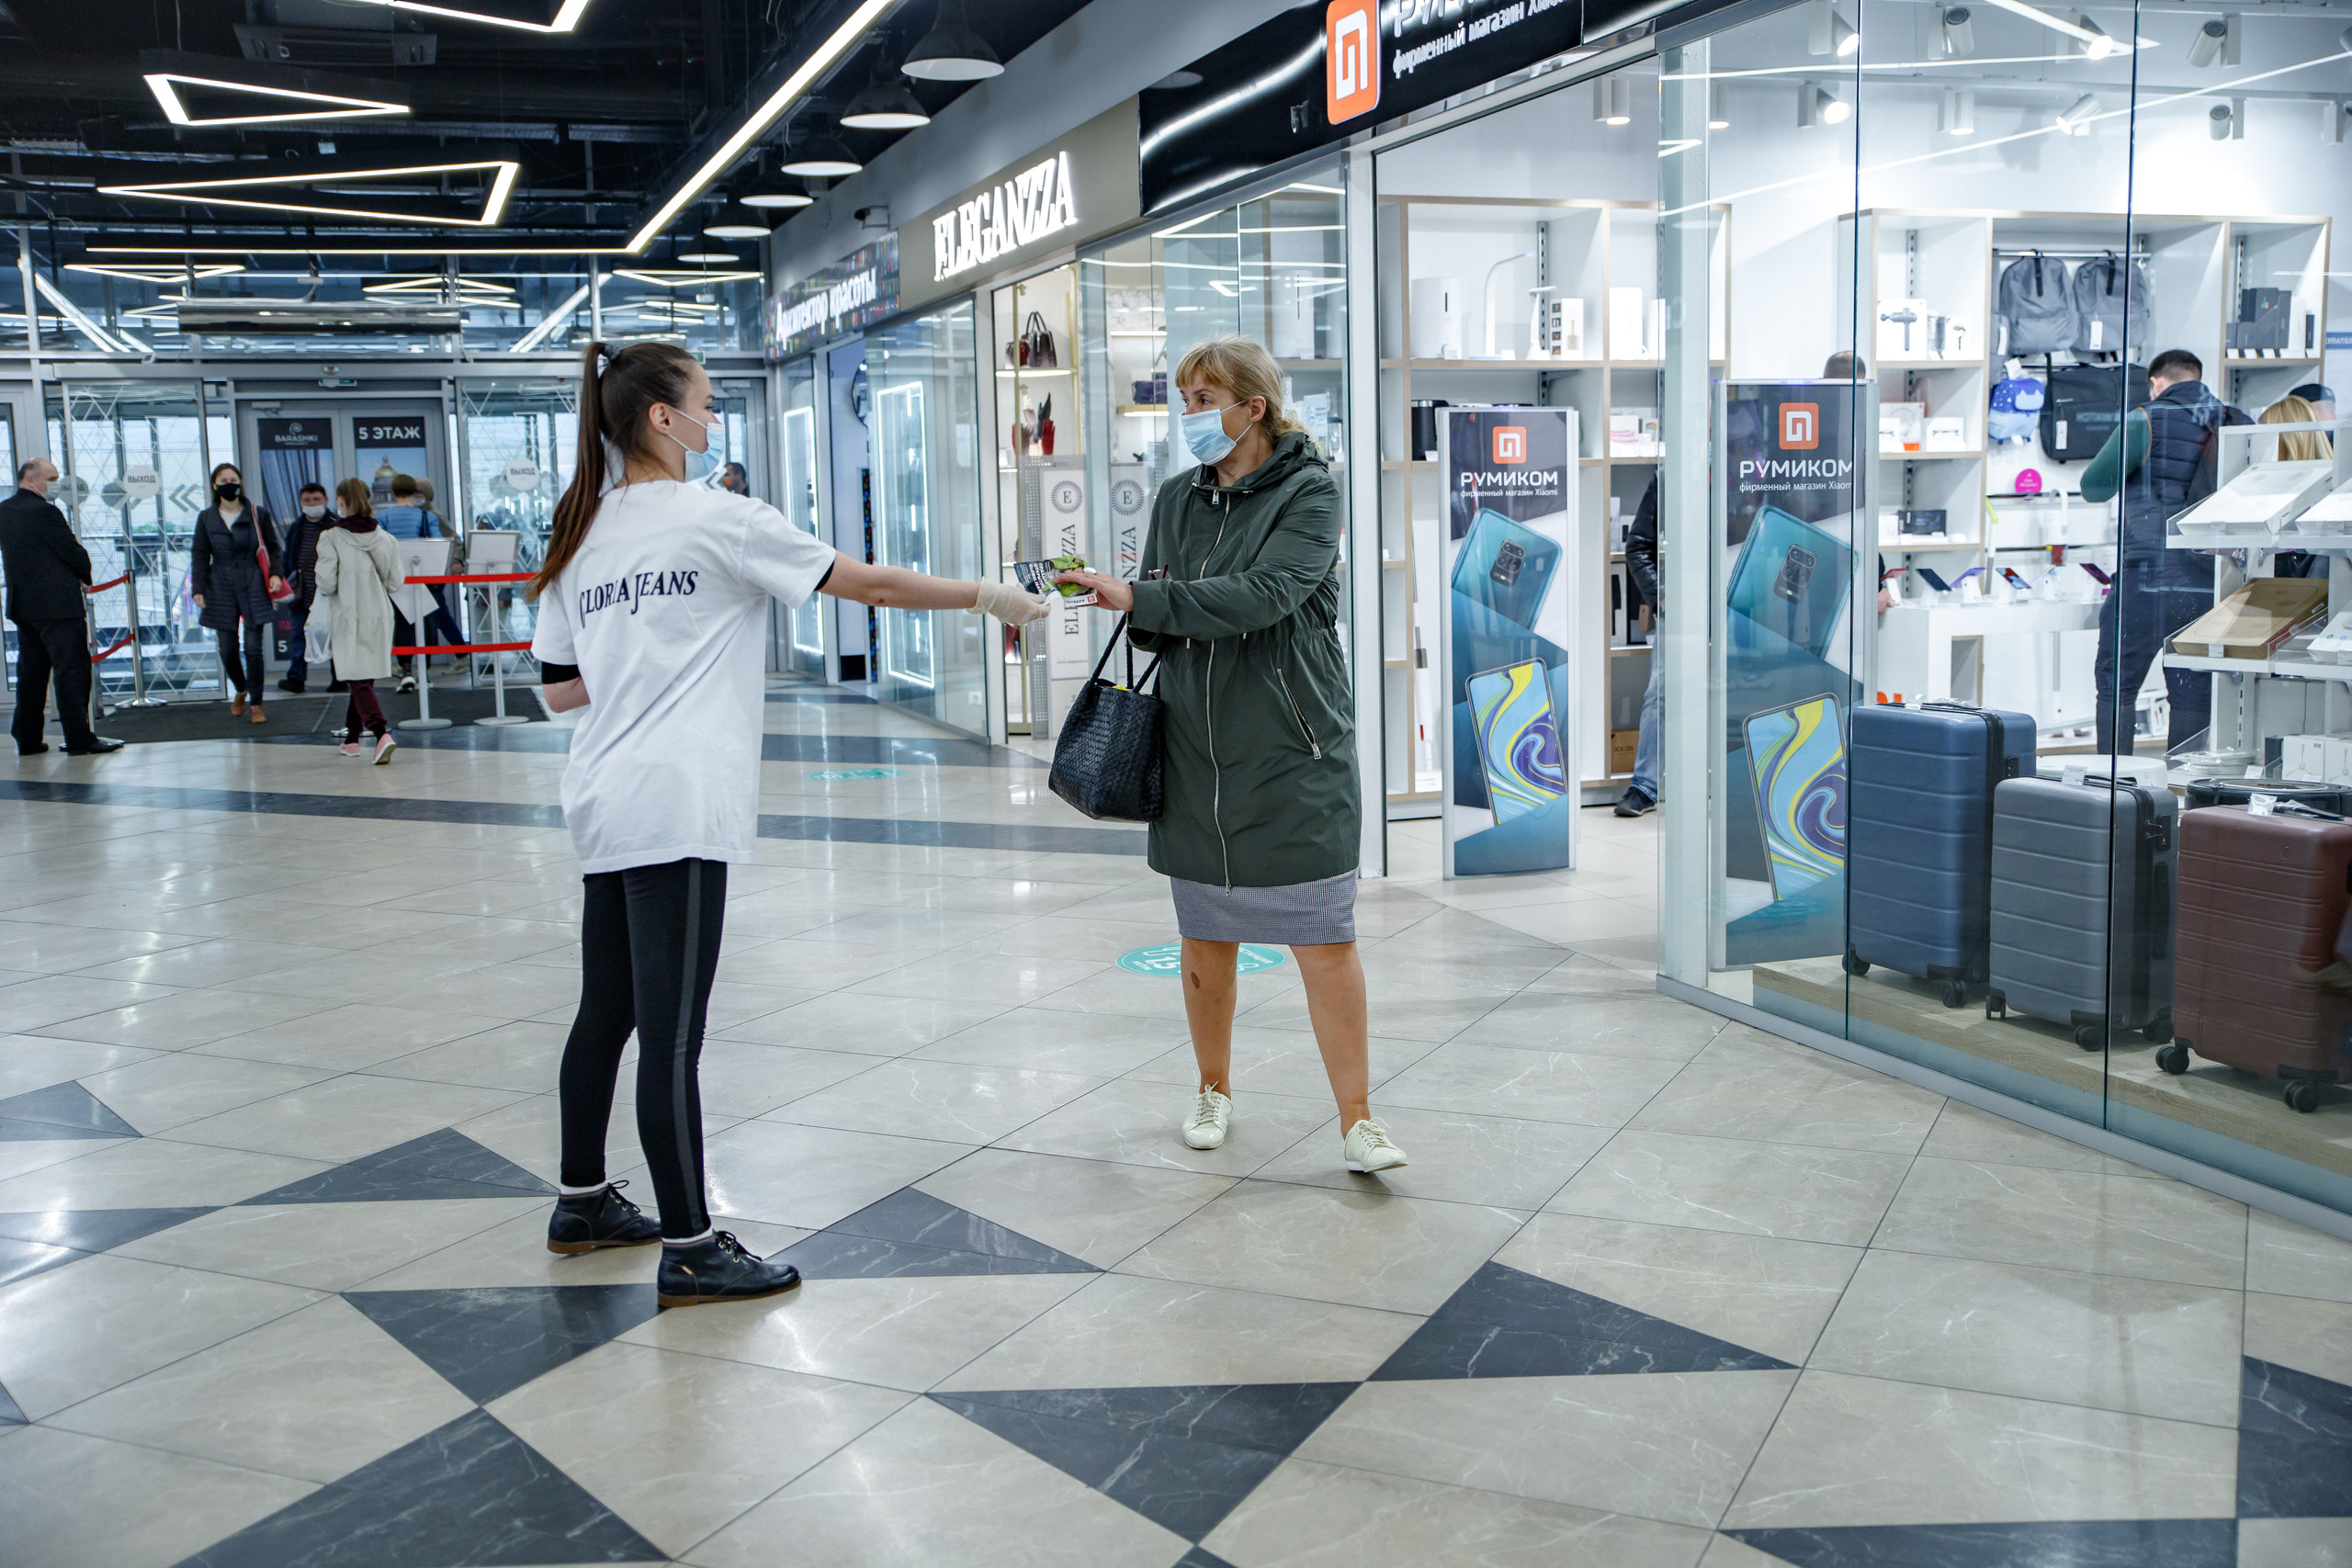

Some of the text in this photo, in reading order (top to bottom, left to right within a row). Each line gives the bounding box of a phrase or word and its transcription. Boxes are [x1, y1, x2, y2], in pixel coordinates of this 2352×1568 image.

[1393, 21, 1466, 79] фирменный
[1468, 2, 1524, 41] магазин
[933, 151, 1079, 282] ELEGANZZA
[776, 267, 876, 352] Архитектор красоты
[358, 426, 421, 440] 5 ЭТАЖ
[1739, 458, 1853, 479] РУМИКОМ
[127, 475, 156, 483] ВЫХОД
[1460, 470, 1558, 487] РУМИКОМ
[1460, 489, 1504, 499] фирменный
[1535, 488, 1558, 496] Xiaomi
[1739, 480, 1852, 493] фирменный магазин Xiaom
[1063, 491, 1072, 504] E
[1123, 491, 1132, 505] E
[630, 570, 698, 615] JEANS
[278, 640, 288, 652] 5
